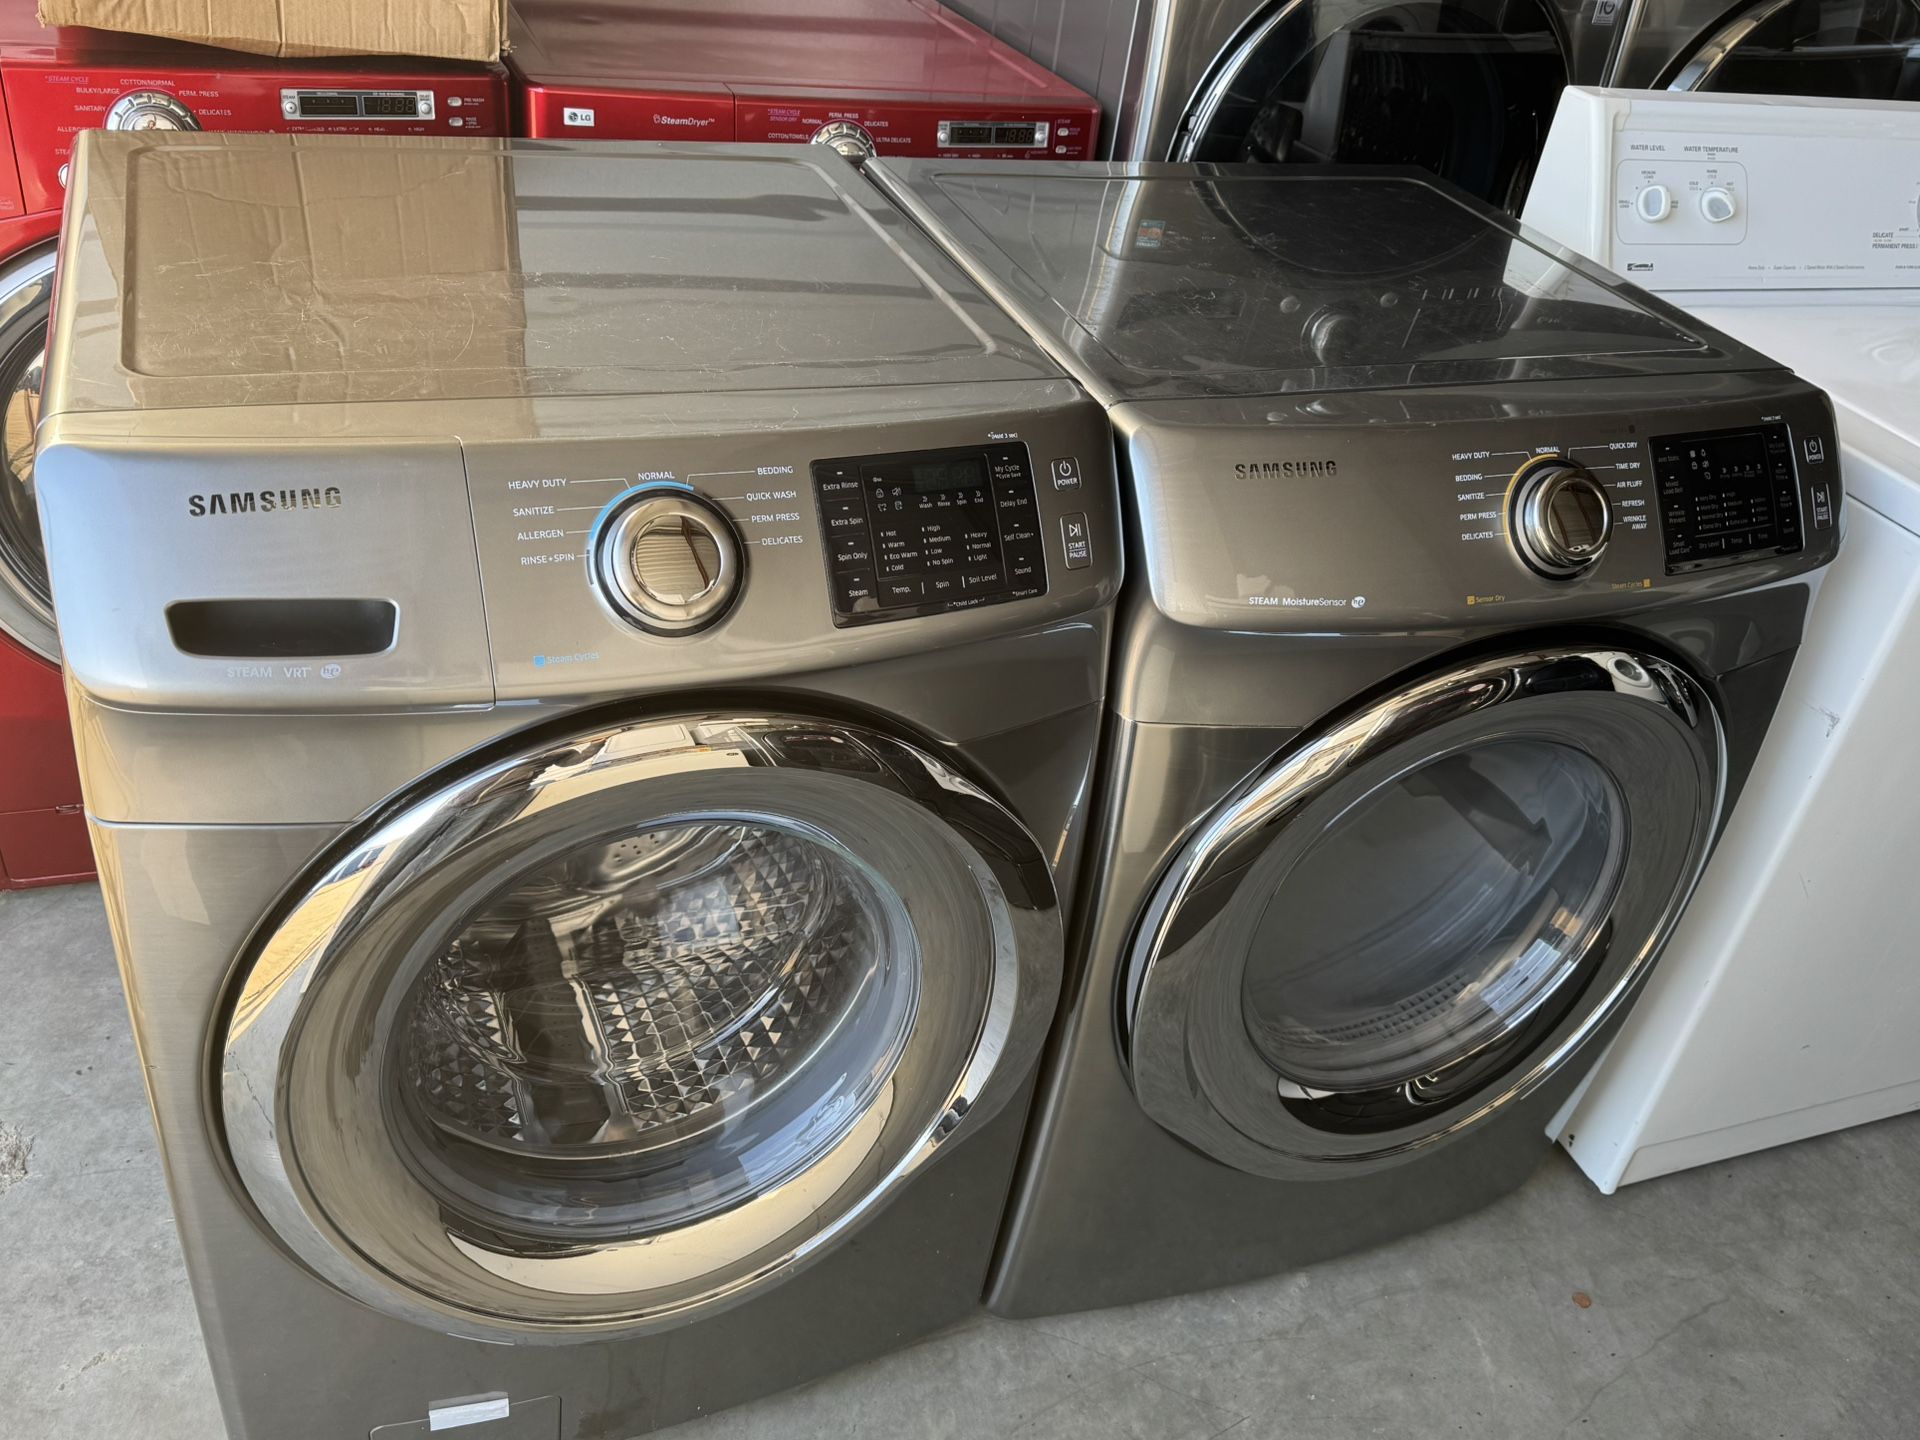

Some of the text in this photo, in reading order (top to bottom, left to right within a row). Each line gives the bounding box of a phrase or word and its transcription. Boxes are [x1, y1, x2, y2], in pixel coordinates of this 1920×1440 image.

[580, 113, 591, 122] LG
[1452, 451, 1490, 461] HEAVY DUTY
[757, 466, 793, 475] BEDDING
[995, 464, 1020, 474] My Cycle
[1235, 461, 1337, 480] SAMSUNG
[638, 472, 675, 480] NORMAL
[1455, 474, 1482, 482] BEDDING
[508, 479, 567, 490] HEAVY DUTY
[1057, 477, 1078, 486] POWER
[1627, 480, 1643, 488] FLUFF
[823, 483, 840, 491] Extra
[746, 491, 796, 501] QUICK WASH
[1458, 492, 1485, 501] SANITIZE
[188, 487, 342, 517] SAMSUNG
[1000, 500, 1016, 508] Delay
[513, 506, 555, 517] SANITIZE
[1460, 511, 1497, 520] PERM PRESS
[752, 513, 800, 523] PERM PRESS
[849, 517, 863, 525] Spin
[1623, 515, 1646, 523] WRINKLE
[517, 529, 564, 541] ALLERGEN
[1004, 534, 1016, 542] Self
[1462, 531, 1494, 540] DELICATES
[762, 536, 803, 546] DELICATES
[1068, 541, 1086, 550] START
[838, 553, 852, 561] Spin
[1069, 550, 1087, 559] PAUSE
[942, 558, 954, 566] Spin
[1015, 566, 1032, 575] Sound
[969, 573, 997, 584] Soil Level
[848, 589, 869, 597] Steam
[1248, 597, 1278, 605] STEAM
[1282, 598, 1347, 606] MoistureSensor
[227, 666, 272, 678] STEAM
